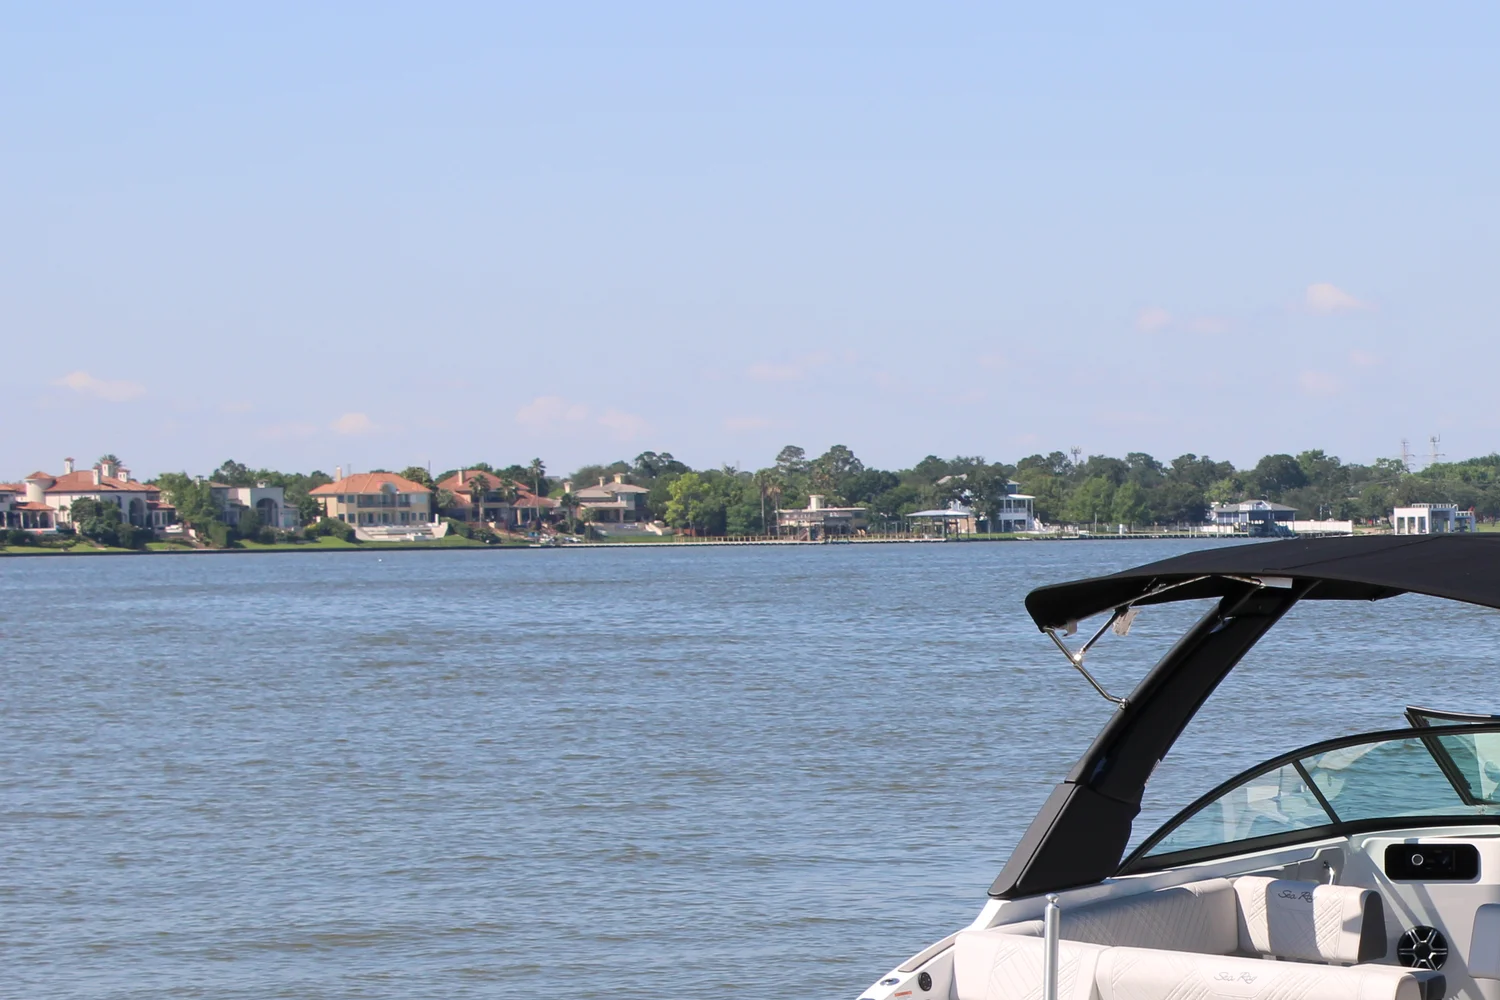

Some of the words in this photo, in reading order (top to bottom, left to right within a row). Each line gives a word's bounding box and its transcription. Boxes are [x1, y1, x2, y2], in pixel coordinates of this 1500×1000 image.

[1277, 889, 1296, 900] Sea
[1213, 971, 1235, 982] Sea
[1236, 971, 1258, 985] Ray
